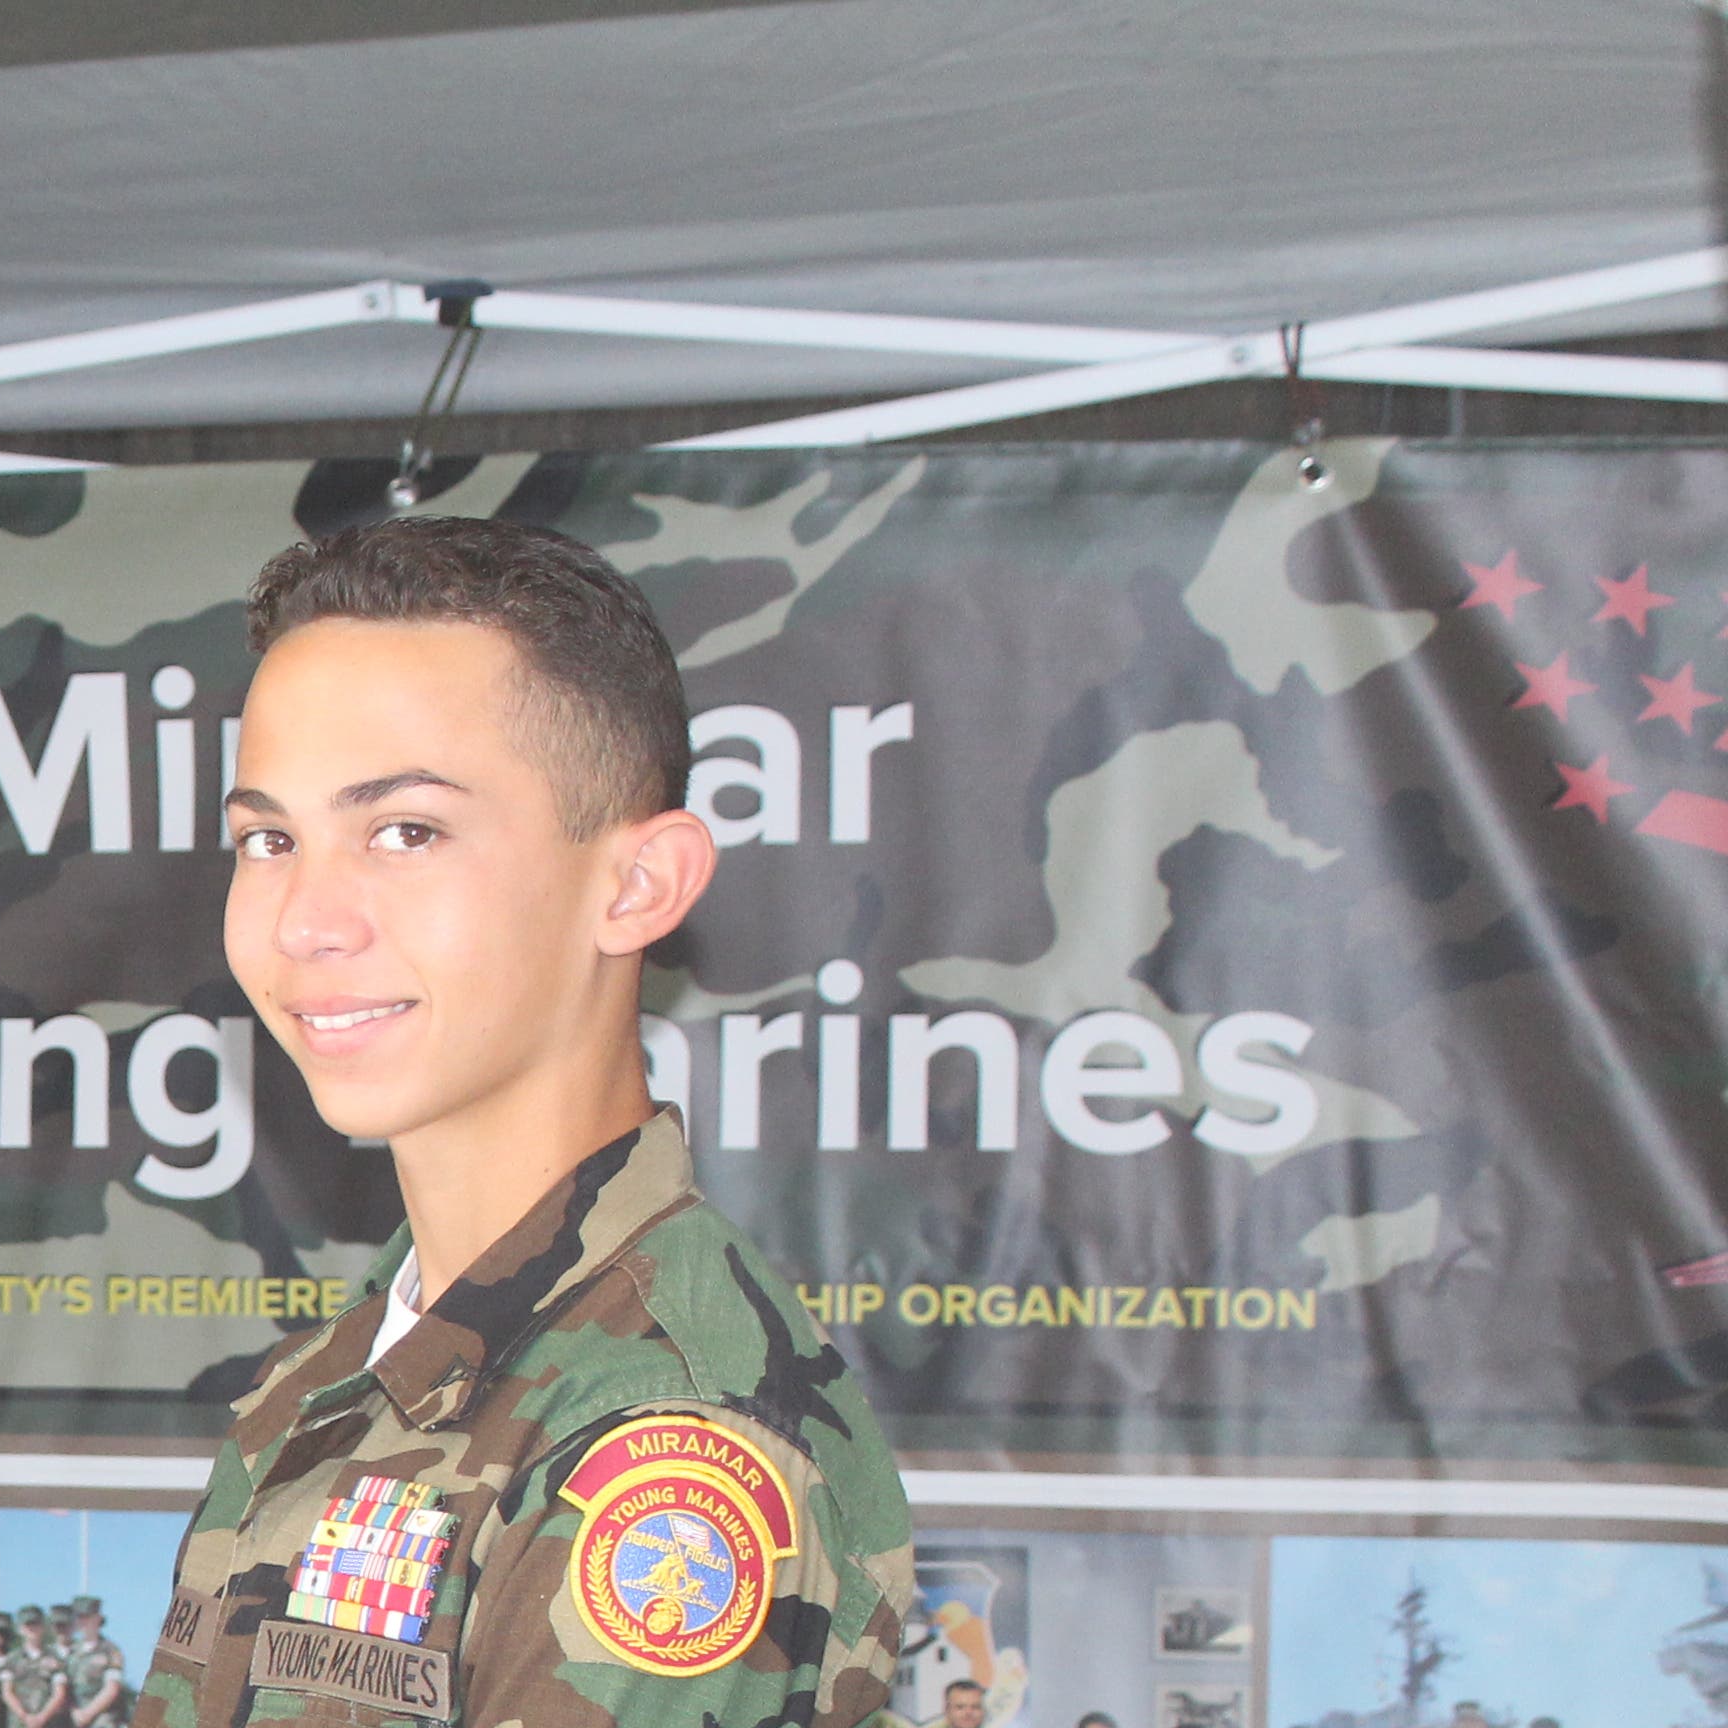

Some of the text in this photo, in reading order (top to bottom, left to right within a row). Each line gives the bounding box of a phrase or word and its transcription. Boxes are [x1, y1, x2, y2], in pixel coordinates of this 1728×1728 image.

[108, 1275, 347, 1319] PREMIERE
[898, 1282, 1317, 1331] ORGANIZATION
[625, 1431, 764, 1491] MIRAMAR
[608, 1486, 755, 1562] YOUNG MARINES
[624, 1529, 730, 1573] SEMPER FIDELIS
[264, 1628, 438, 1709] YOUNG MARINES
